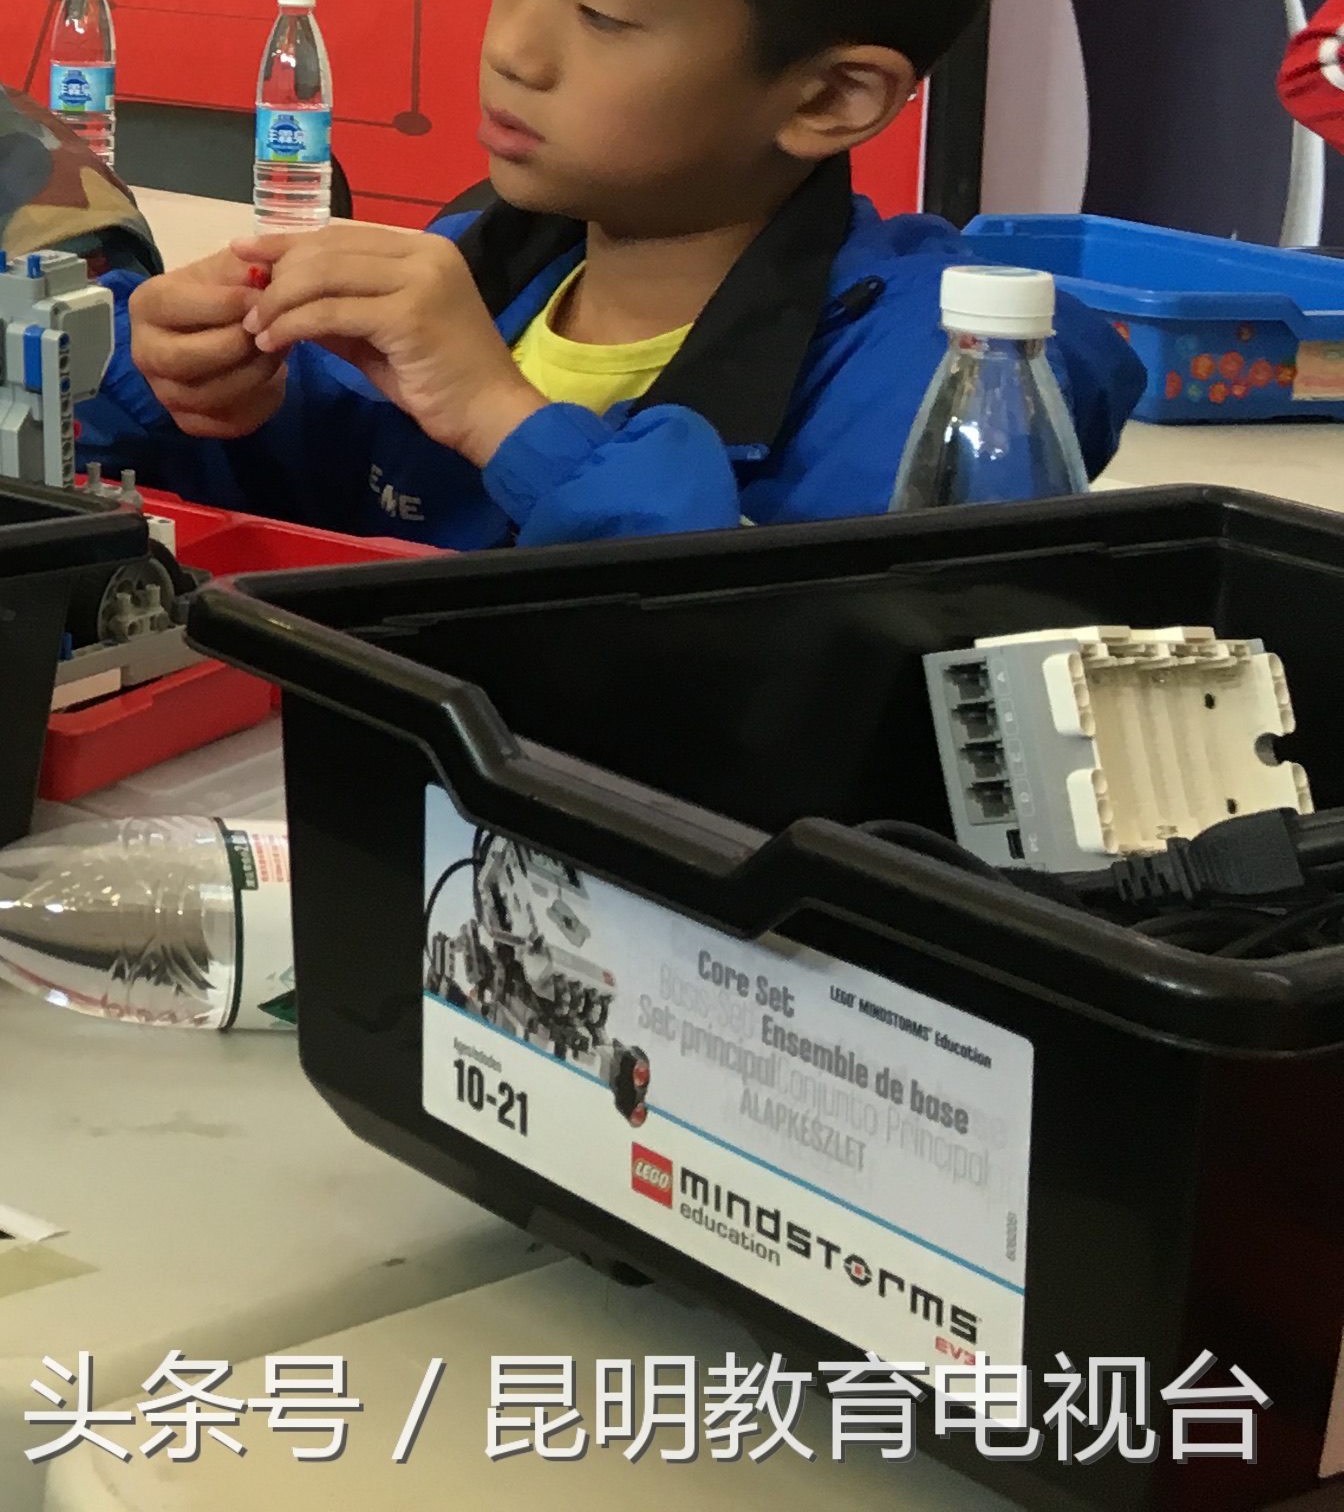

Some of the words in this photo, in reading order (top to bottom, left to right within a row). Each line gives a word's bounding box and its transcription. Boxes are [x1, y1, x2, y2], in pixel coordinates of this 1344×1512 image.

[638, 994, 676, 1041] Set
[698, 949, 750, 999] Core
[755, 975, 795, 1018] Set
[761, 1015, 869, 1088] Ensemble
[874, 1067, 904, 1104] de
[909, 1079, 969, 1134] base
[934, 1030, 992, 1069] Education
[453, 1058, 528, 1137] 10-21
[634, 1159, 671, 1192] LEGO
[679, 1165, 980, 1345] mindstorms
[679, 1201, 781, 1268] education
